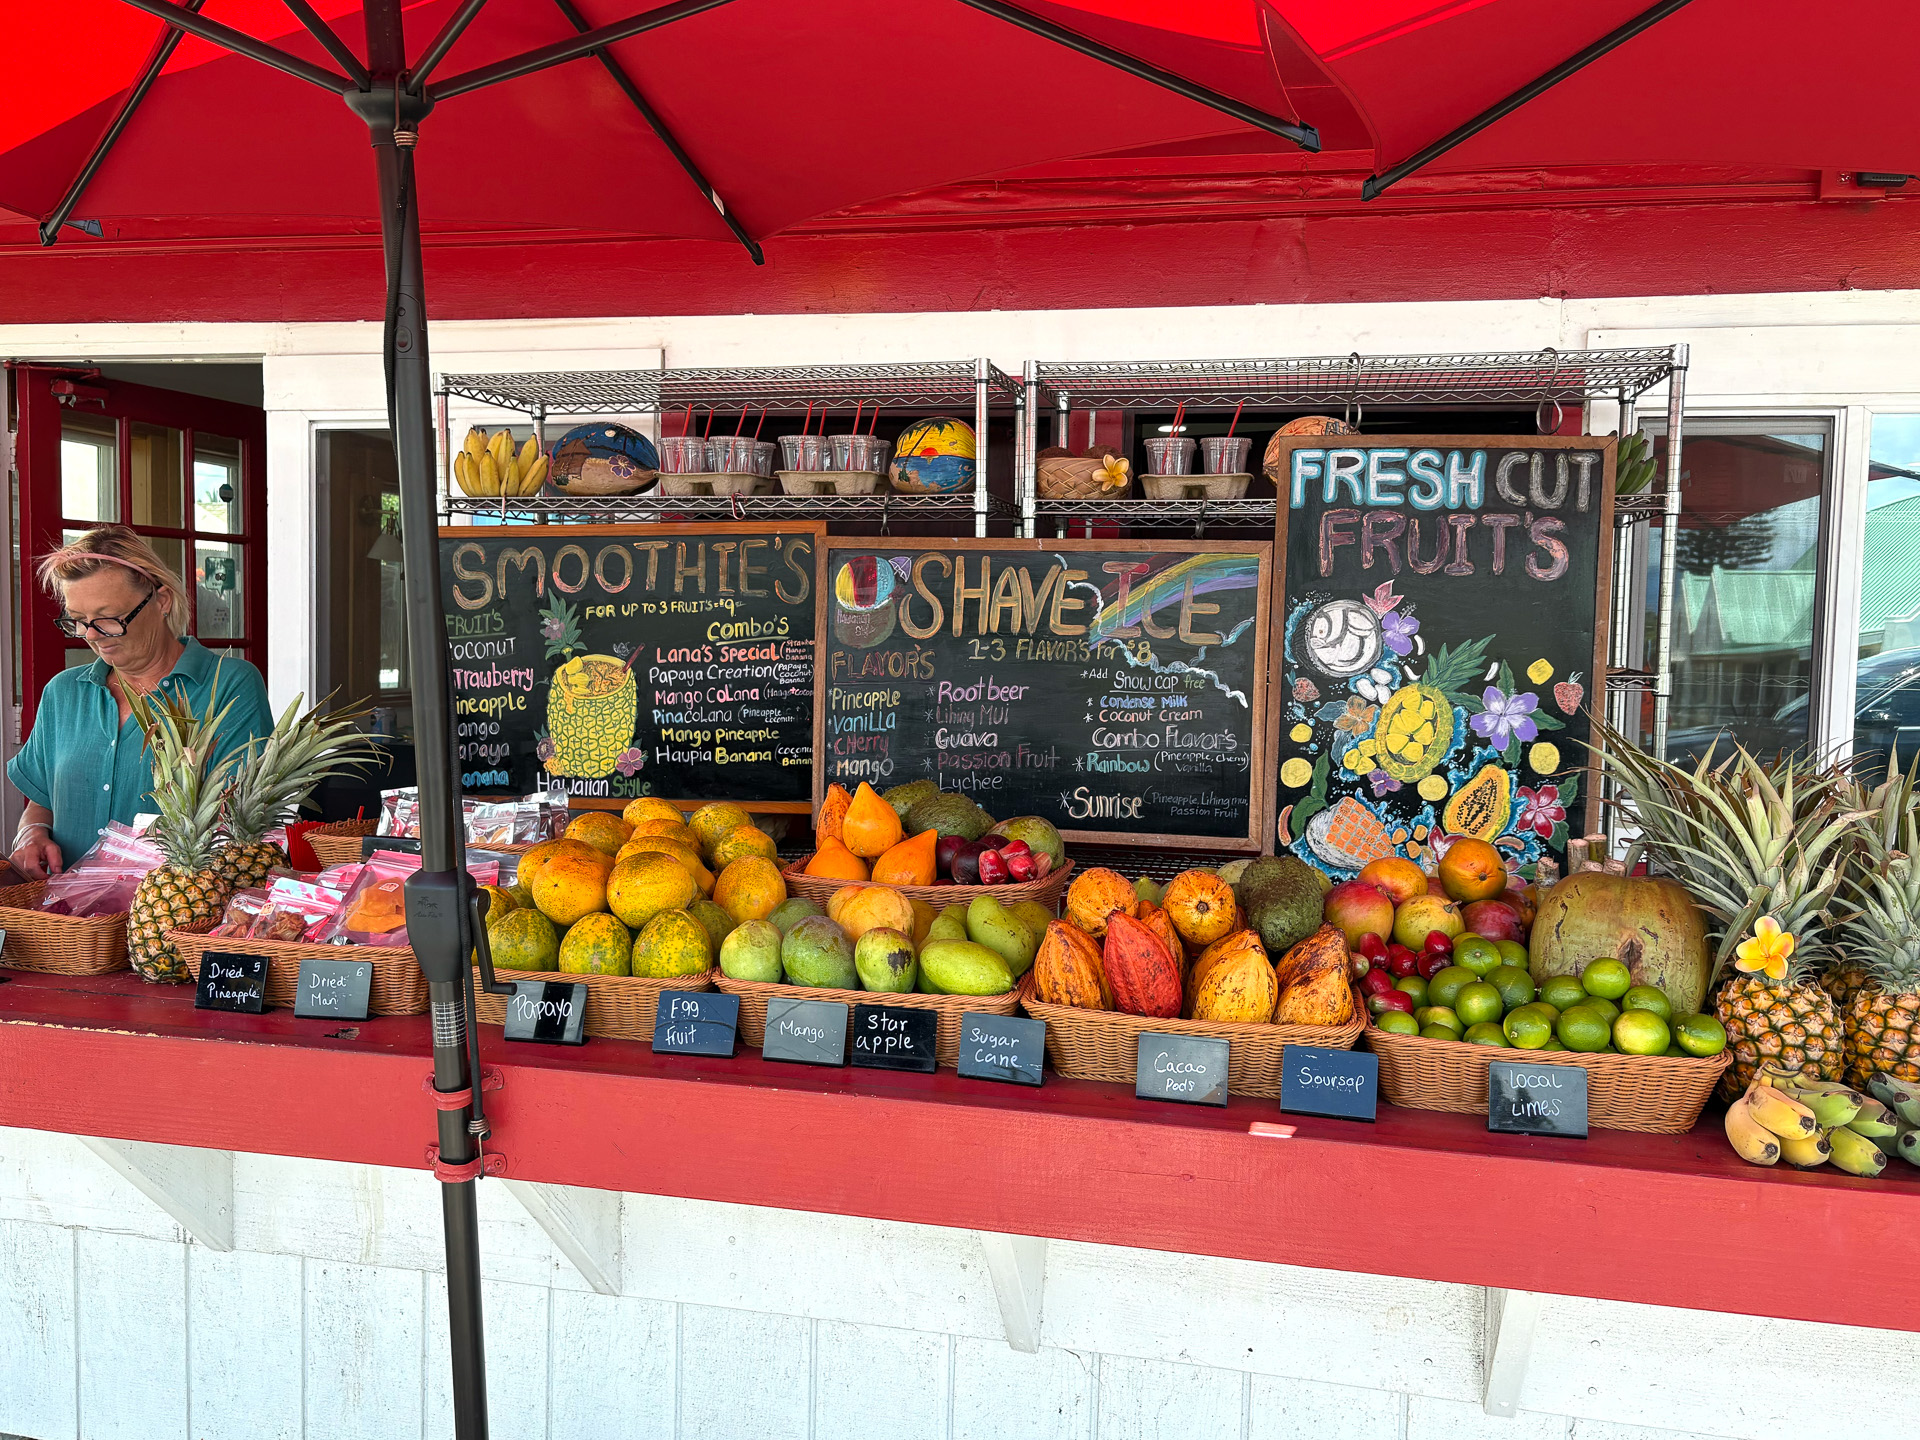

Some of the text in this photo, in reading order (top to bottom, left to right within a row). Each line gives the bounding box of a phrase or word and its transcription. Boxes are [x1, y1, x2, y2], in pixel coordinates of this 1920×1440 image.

[1290, 448, 1600, 512] FRESH CUT
[1319, 508, 1570, 582] FRUIT'S
[452, 531, 813, 611] SMOOTHIE'S
[586, 604, 616, 621] FOR
[622, 602, 638, 617] UP
[642, 602, 656, 614] TO
[659, 600, 668, 615] 3
[1098, 560, 1226, 647] ICE
[968, 638, 1008, 662] 1-3
[649, 666, 704, 687] Papaya
[1182, 674, 1206, 690] free
[456, 692, 528, 721] ineapple
[655, 690, 703, 711] Mango
[831, 687, 901, 712] Pineapple
[1098, 709, 1153, 723] Coconut
[457, 721, 501, 741] ango
[661, 728, 711, 748] Mango
[935, 727, 998, 750] Guava
[1091, 726, 1160, 749] Combo
[656, 744, 712, 766] Haupia
[715, 747, 772, 765] Banana
[937, 742, 1060, 770] Passion Fruit
[1086, 751, 1151, 774] Rainbow
[461, 769, 510, 789] anana
[836, 757, 895, 785] Mango
[939, 771, 1003, 794] Lychee
[1068, 786, 1146, 819] Sunrise
[1170, 806, 1240, 818] Passion Fruit
[208, 961, 262, 980] Dried 5
[308, 966, 365, 989] Dried 6
[206, 981, 260, 1005] Pineapple
[512, 994, 574, 1026] Papaya
[779, 1019, 826, 1044] Mango
[856, 1034, 915, 1054] apple
[1154, 1051, 1208, 1075] Cacao
[1297, 1066, 1366, 1093] Soursop
